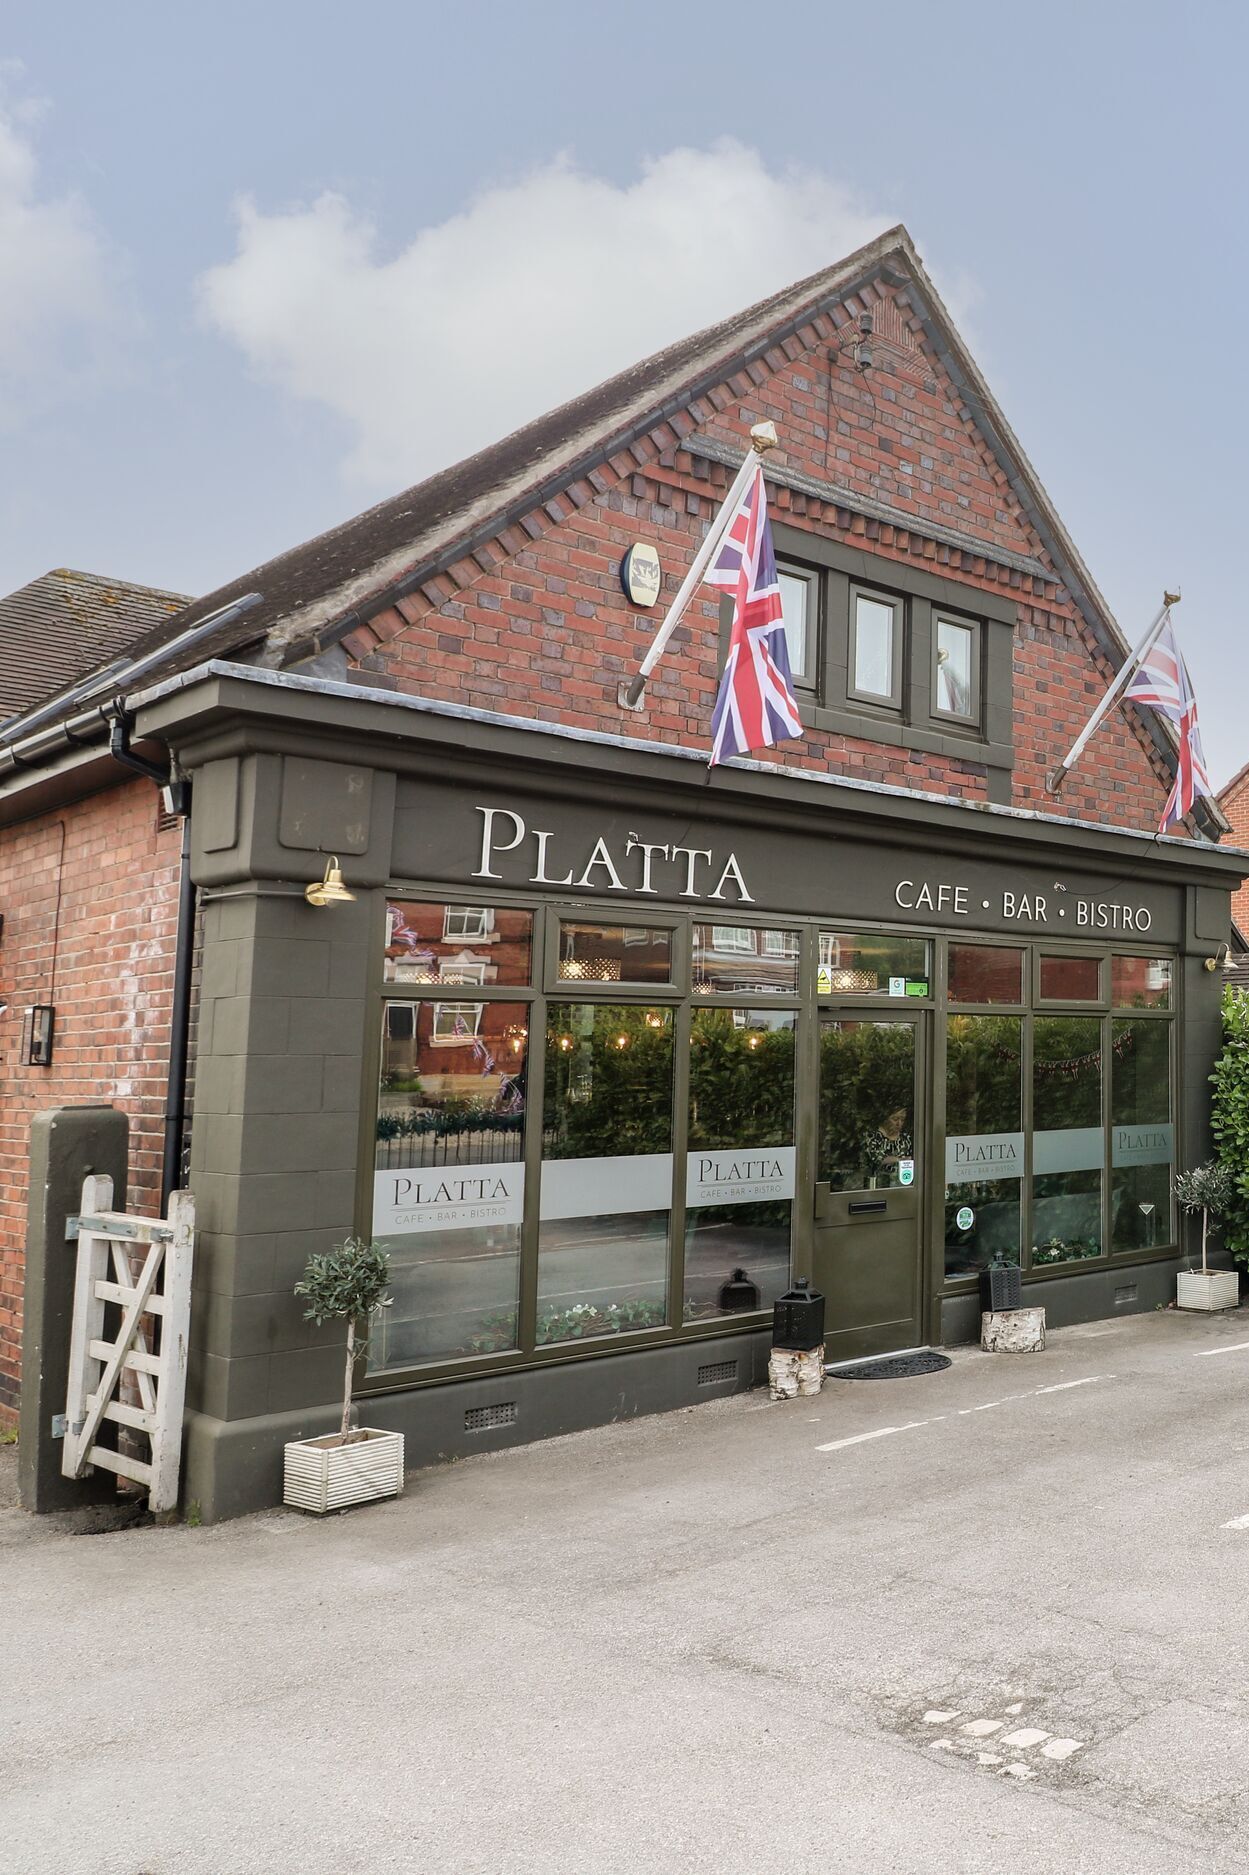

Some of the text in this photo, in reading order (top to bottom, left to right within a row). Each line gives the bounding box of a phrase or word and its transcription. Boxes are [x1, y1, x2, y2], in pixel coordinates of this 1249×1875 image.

[470, 805, 756, 903] PLATTA
[895, 880, 1152, 932] CAFE BAR BISTRO
[955, 1142, 1016, 1163] PLATTA
[698, 1159, 784, 1182] PLATTA
[393, 1178, 510, 1206] PLATTA
[700, 1185, 782, 1199] CAFE BAR BISTRO
[395, 1207, 507, 1225] CAFE BAR BISTRO
